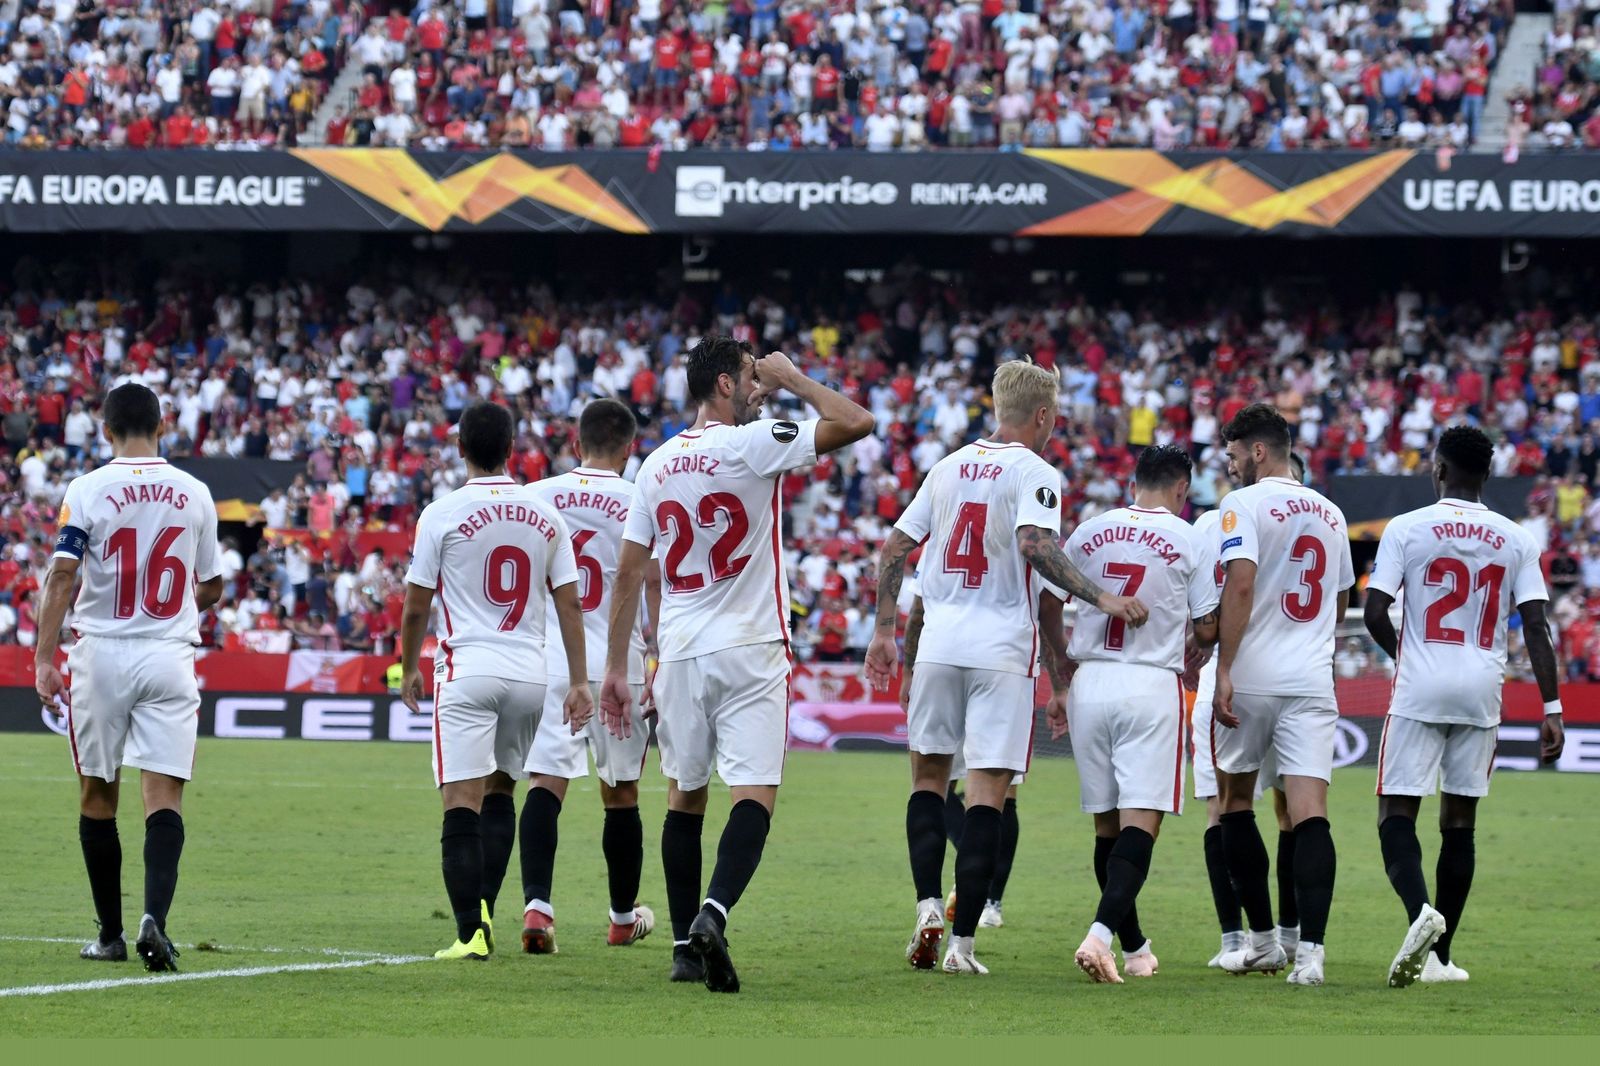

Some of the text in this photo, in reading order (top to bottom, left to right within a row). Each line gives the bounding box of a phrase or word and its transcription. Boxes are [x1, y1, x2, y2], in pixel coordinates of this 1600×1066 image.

[0, 175, 36, 204] FA
[42, 175, 169, 205] EUROPA
[176, 176, 305, 205] LEAGUE
[678, 168, 898, 212] enterprise
[911, 183, 1048, 205] RENT-A-CAR
[1403, 178, 1600, 212] UEFA EURO
[655, 453, 720, 486] VAZQUEZ
[960, 463, 1003, 482] KJÆR
[106, 484, 188, 514] J.NAVAS
[1270, 498, 1339, 532] S.GOMEZ
[656, 492, 752, 594] 22
[943, 501, 989, 590] 4
[1081, 526, 1181, 566] ROQUE MESA
[1432, 522, 1505, 550] PROMES
[103, 526, 187, 620] 16
[483, 545, 531, 632] 9
[1281, 535, 1327, 623] 3
[1102, 562, 1147, 652] 7
[1424, 557, 1507, 651] 21
